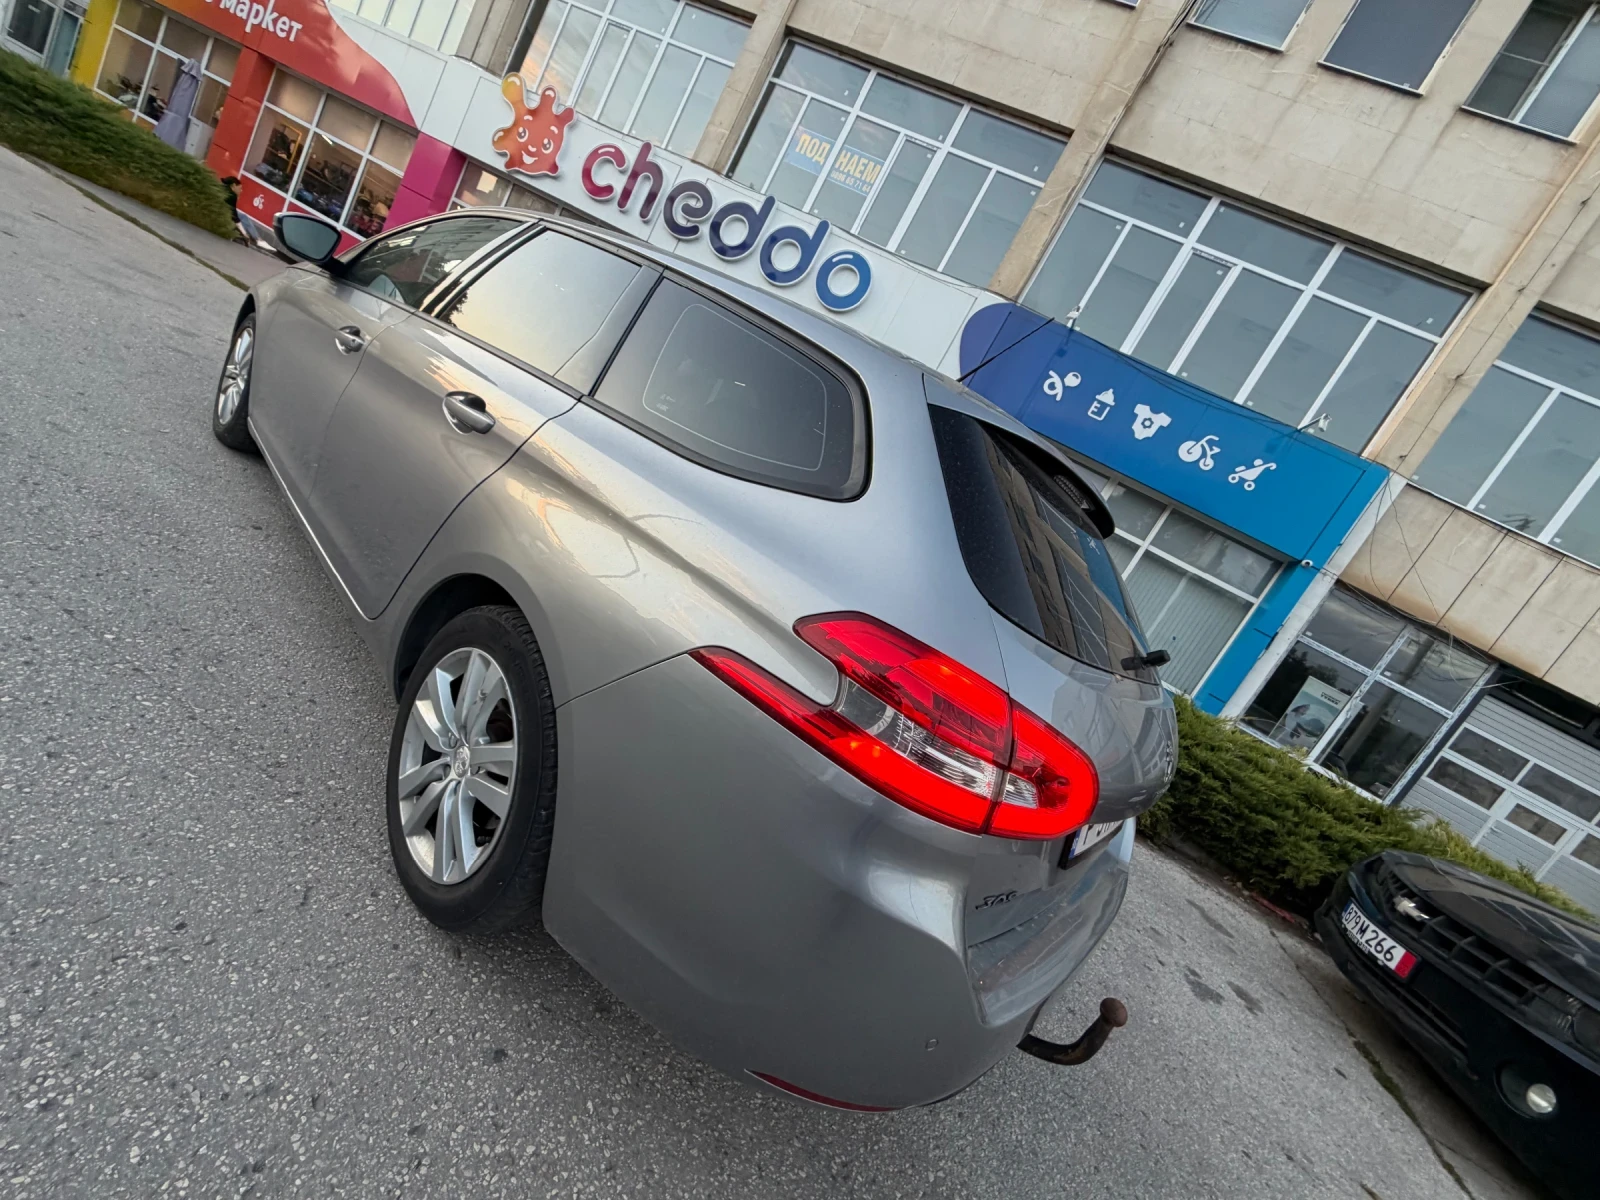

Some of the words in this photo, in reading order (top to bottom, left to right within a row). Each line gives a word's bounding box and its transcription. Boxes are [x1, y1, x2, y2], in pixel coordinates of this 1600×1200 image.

[795, 133, 831, 166] ПОД
[835, 150, 882, 184] НАЕМ
[580, 140, 873, 312] cheddo
